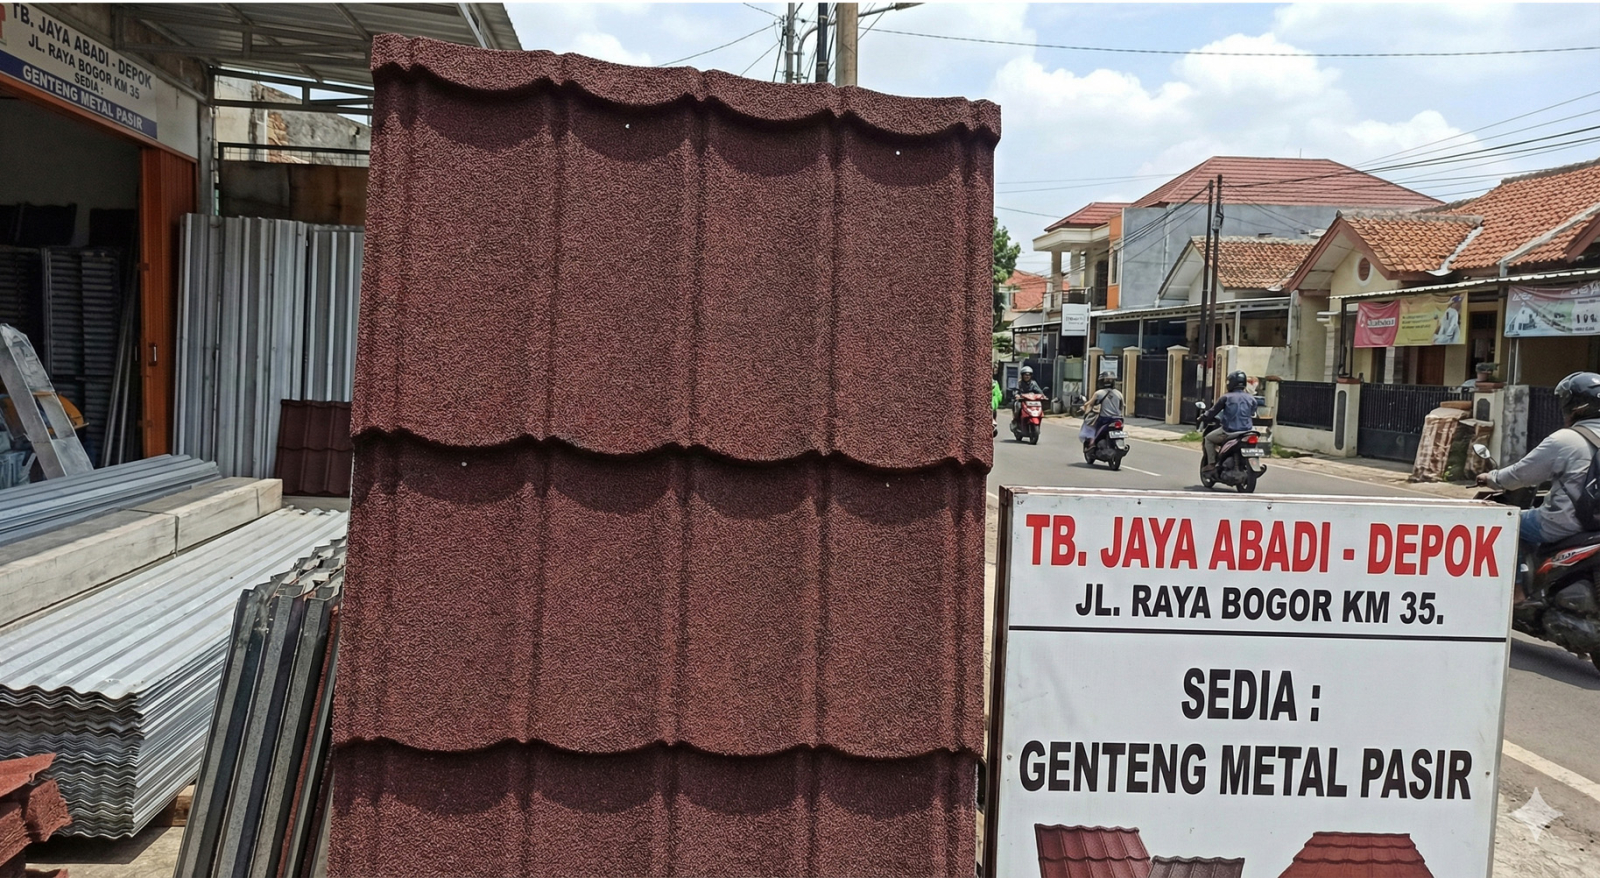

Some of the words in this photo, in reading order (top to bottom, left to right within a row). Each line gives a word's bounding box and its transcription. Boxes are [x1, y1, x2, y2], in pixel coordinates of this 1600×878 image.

[12, 3, 34, 28] TB.
[38, 16, 71, 48] JAYA
[74, 35, 110, 68] ABADI
[118, 58, 152, 90] DEPOK
[28, 34, 45, 53] JL.
[48, 43, 76, 68] RAYA
[78, 58, 112, 85] BOGOR
[114, 76, 128, 95] KM
[129, 85, 140, 100] 35
[22, 65, 78, 101] GENTENG
[80, 90, 114, 117] METAL
[115, 105, 143, 131] PASIR
[74, 72, 99, 94] SEDIA
[1026, 513, 1087, 567] TB.
[1100, 516, 1198, 570] JAYA
[1208, 519, 1331, 573] ABADI
[1343, 548, 1355, 561] -
[1367, 523, 1502, 577] DEPOK
[1075, 583, 1120, 617] JL.
[1131, 585, 1212, 619] RAYA
[1221, 587, 1332, 623] BOGOR
[1342, 590, 1390, 624] KM
[1399, 591, 1444, 625] 35.
[1181, 667, 1298, 722] SEDIA
[1019, 740, 1207, 795] GENTENG
[1219, 744, 1348, 799] METAL
[1360, 748, 1473, 800] PASIR
